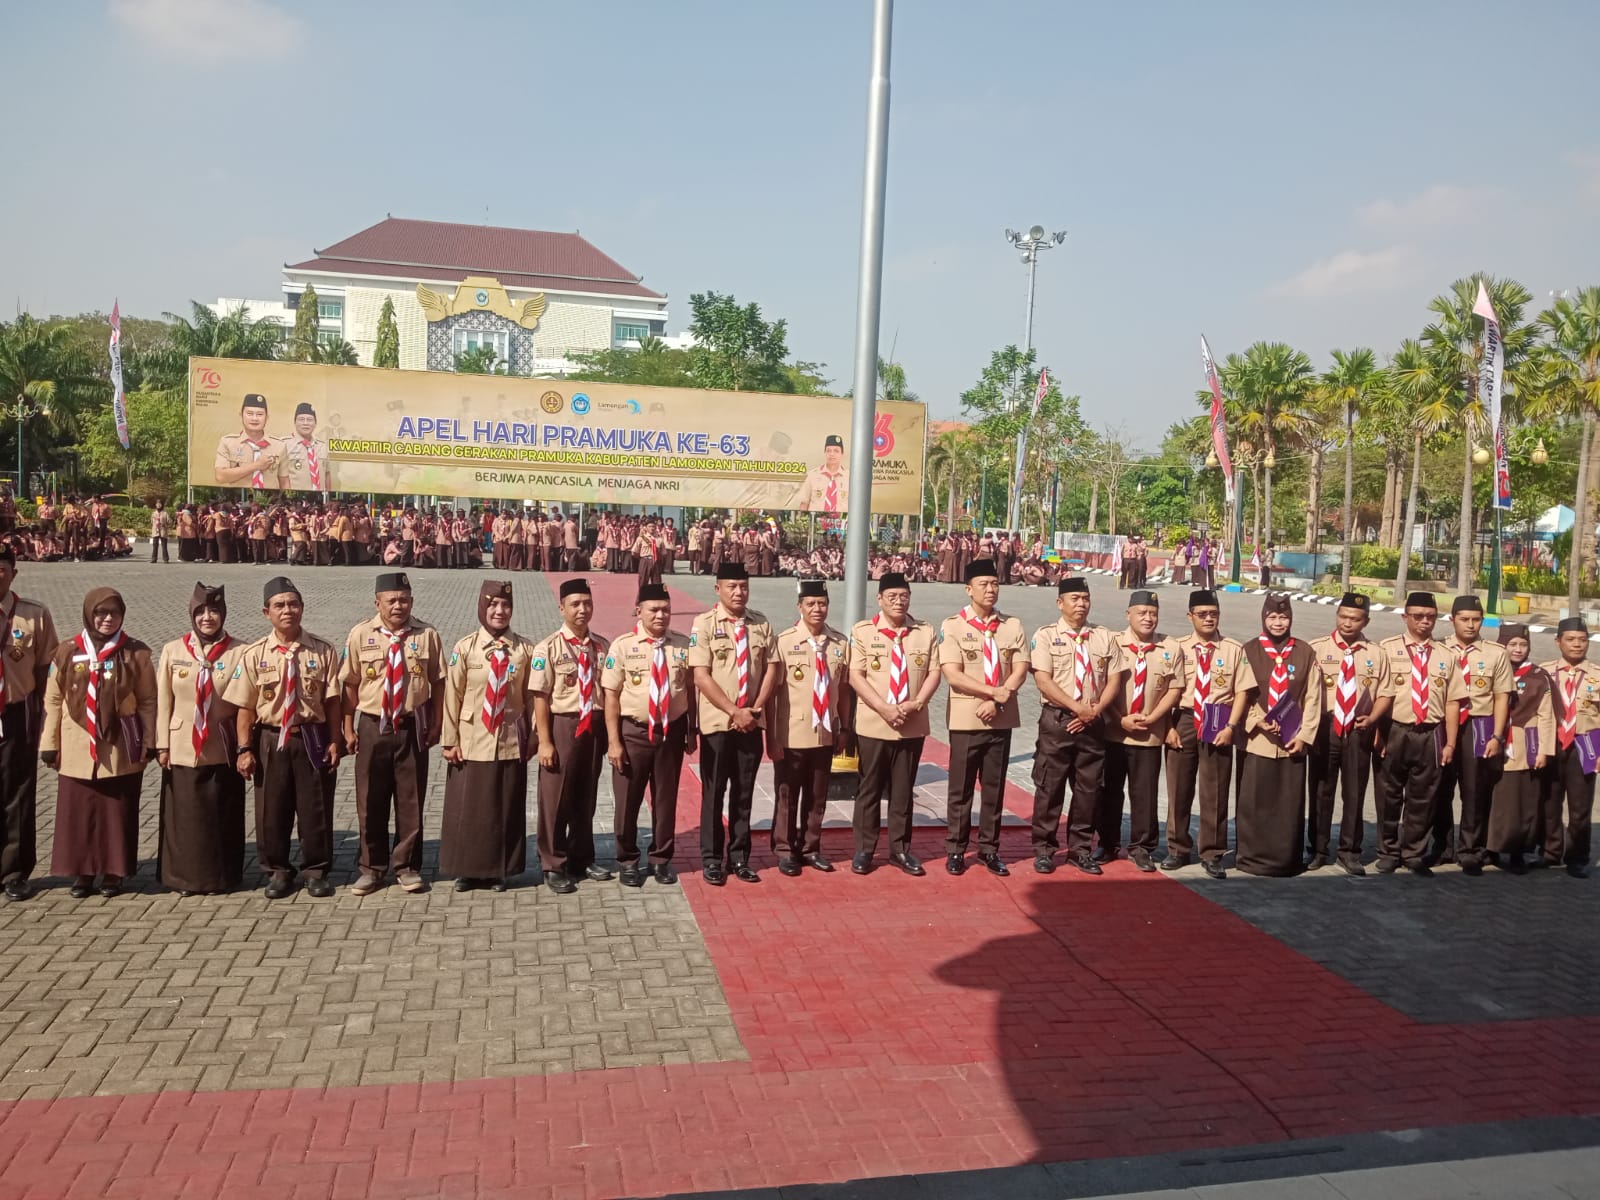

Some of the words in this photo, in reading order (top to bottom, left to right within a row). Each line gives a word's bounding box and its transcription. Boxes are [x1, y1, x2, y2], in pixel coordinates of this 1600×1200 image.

[397, 416, 467, 441] APEL
[473, 419, 537, 446] HARI
[543, 424, 671, 452] PRAMUKA
[677, 431, 750, 456] KE-63
[328, 439, 392, 453] KWARTIR
[394, 442, 451, 457] CABANG
[453, 446, 517, 460] GERAKAN
[519, 449, 584, 464] PRAMUKA
[585, 452, 660, 467] KABUPATEN
[662, 457, 732, 471] LAMONGAN
[734, 459, 775, 473] TAHUN
[776, 461, 807, 474] 2024
[872, 459, 908, 469] RAMUKA
[475, 471, 526, 484] BERJIWA
[528, 474, 593, 487] PANCASILA
[598, 478, 652, 490] MENJAGA
[654, 480, 680, 491] NKRI
